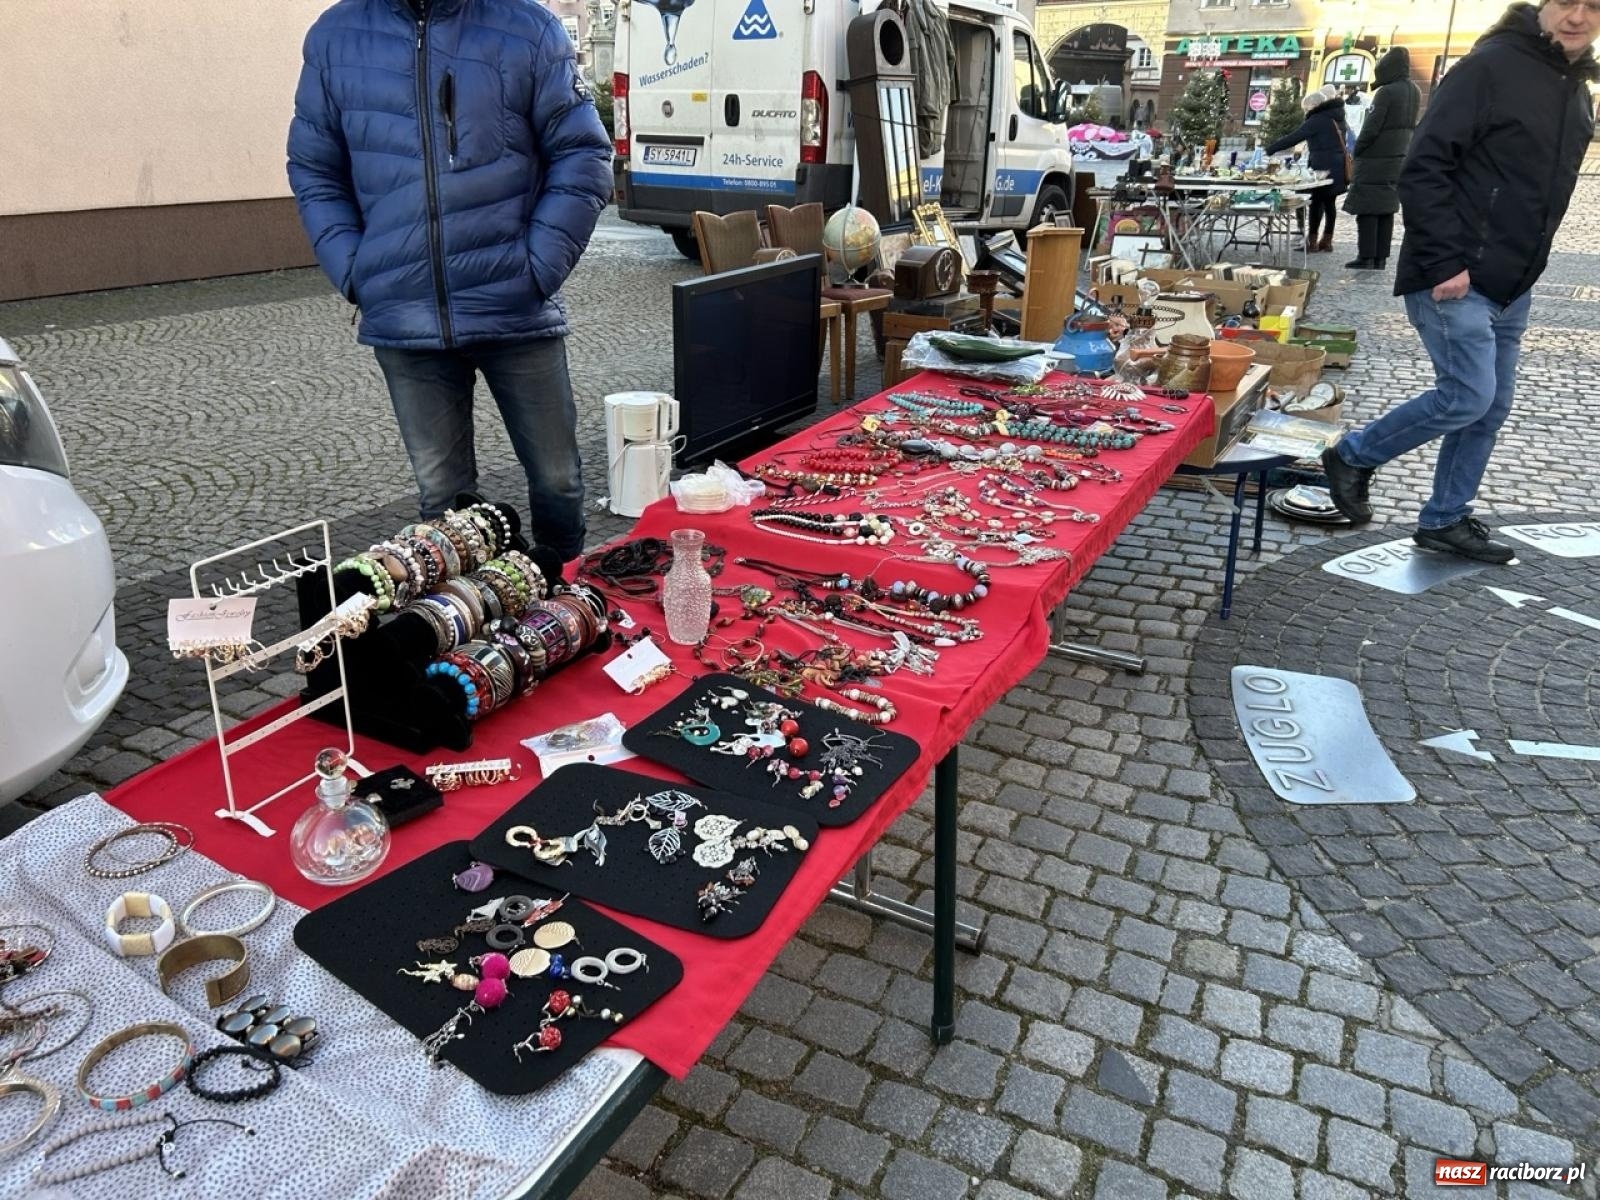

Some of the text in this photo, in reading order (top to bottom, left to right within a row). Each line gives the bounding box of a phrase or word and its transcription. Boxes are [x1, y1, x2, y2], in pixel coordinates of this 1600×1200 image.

[1176, 35, 1300, 54] ATEKA
[639, 52, 709, 87] Wasserschaden?
[751, 109, 797, 119] DUCATO
[650, 148, 691, 162] SY 5941L
[722, 152, 784, 168] 24h-Service
[1242, 673, 1336, 793] ZUGLO
